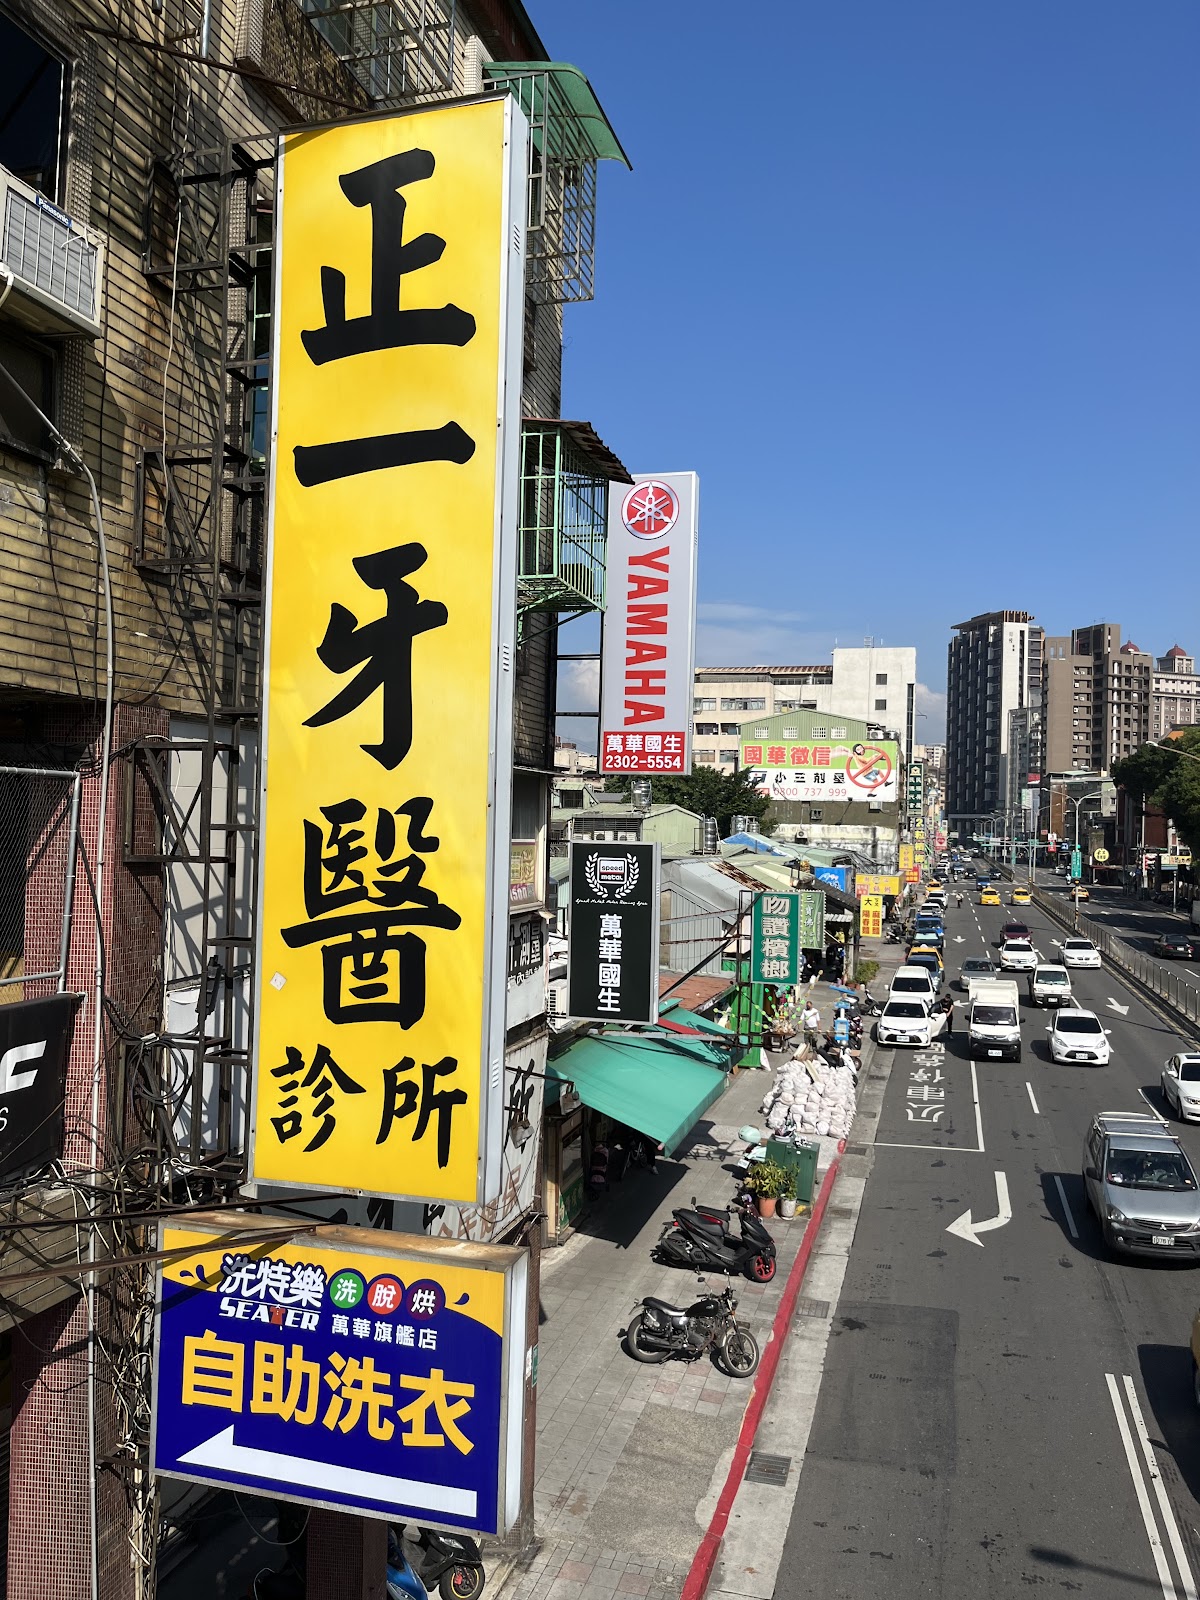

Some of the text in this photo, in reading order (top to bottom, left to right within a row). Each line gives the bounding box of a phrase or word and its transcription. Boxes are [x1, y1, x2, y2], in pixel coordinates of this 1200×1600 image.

[39, 197, 69, 224] Panasonic
[624, 545, 670, 726] YAMAHA
[606, 734, 682, 753] 萬華國生
[743, 745, 831, 766] 國華徵信
[605, 755, 682, 769] 2302-5554
[775, 772, 846, 784] 小三剋星
[804, 787, 822, 796] 737
[828, 788, 847, 797] 999
[762, 895, 790, 979] 吻讚檳榔
[597, 913, 623, 1012] 萬華國生
[270, 1043, 468, 1169] 診所
[219, 1296, 320, 1331] SEATER
[331, 1313, 438, 1351] 萬華旗艦店
[181, 1329, 475, 1456] 自助洗衣
